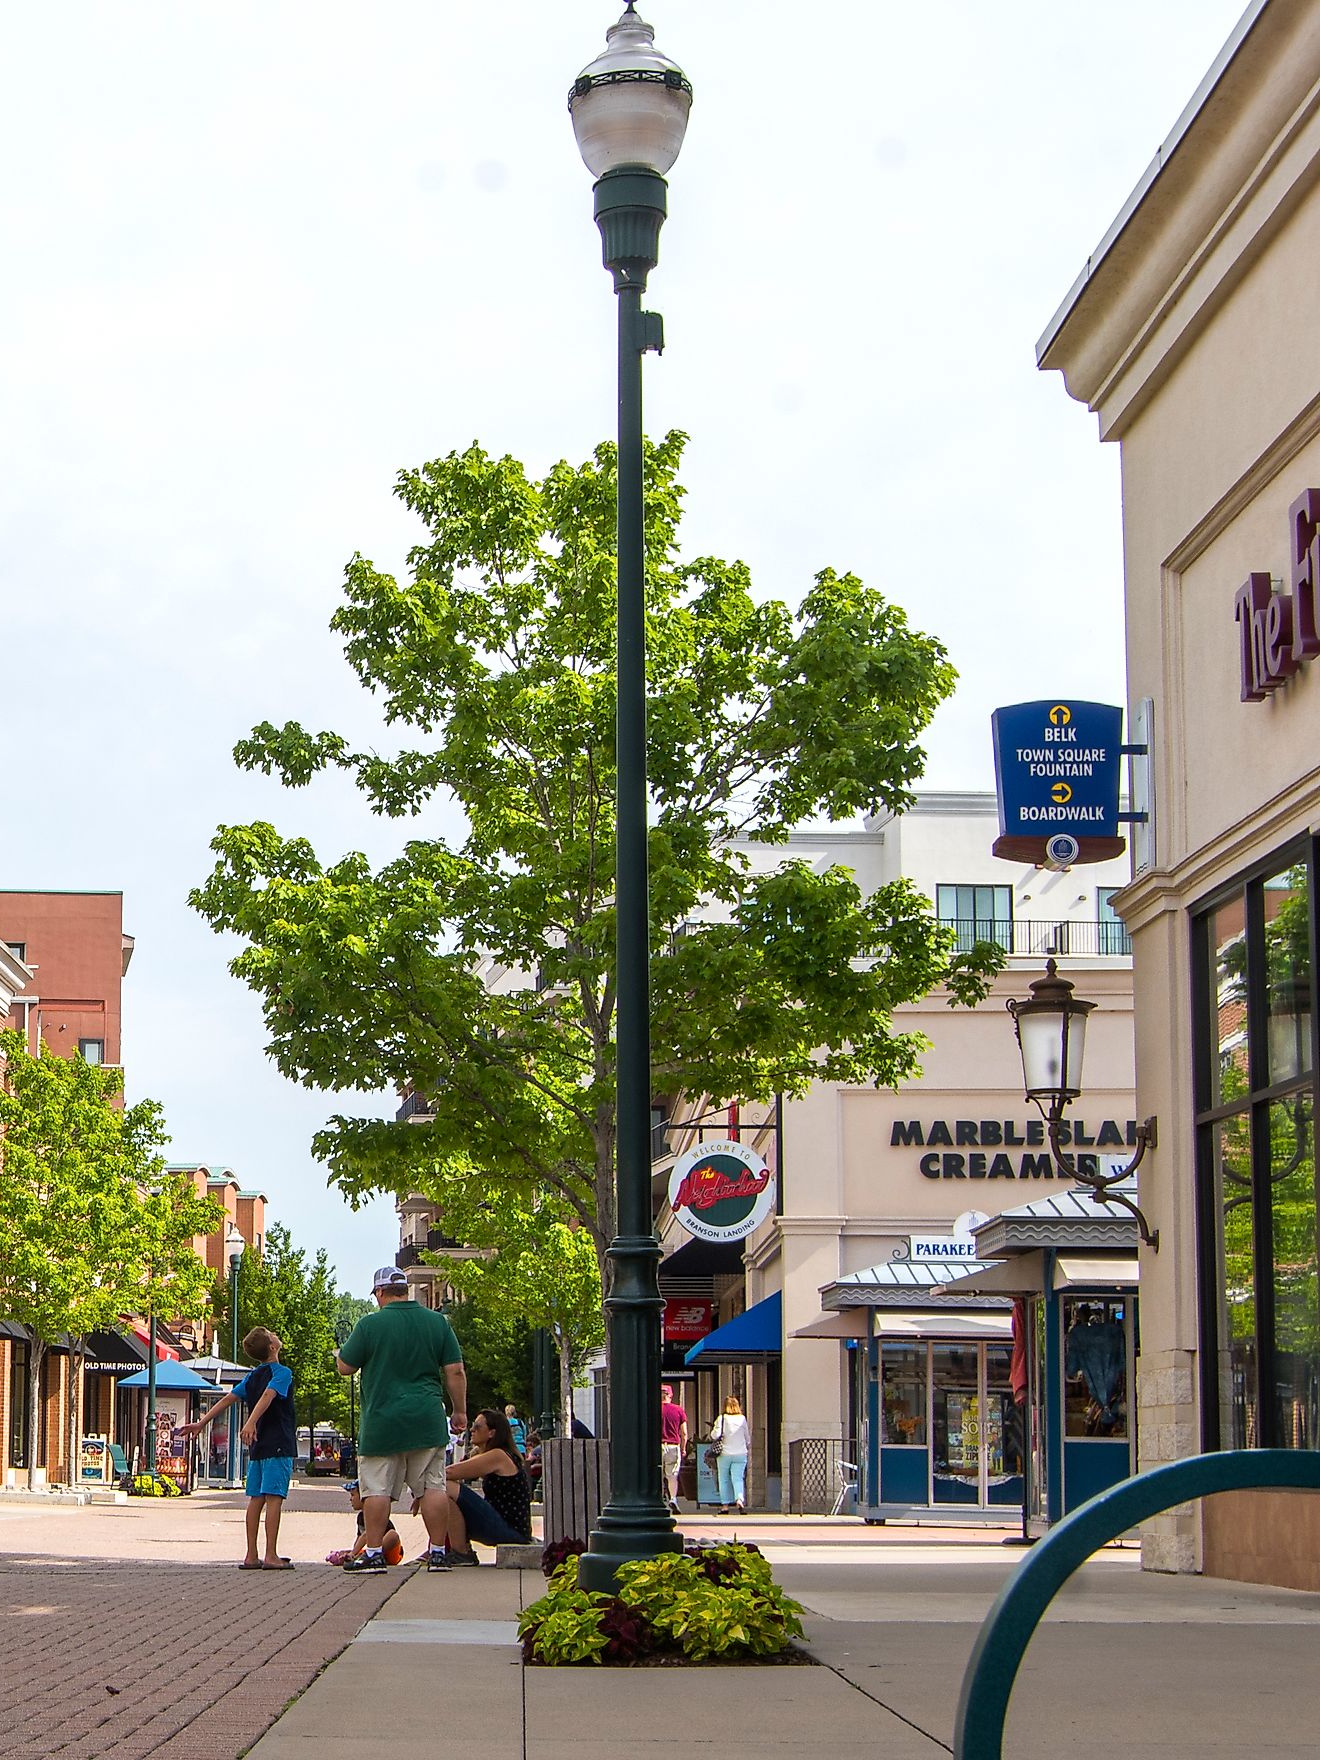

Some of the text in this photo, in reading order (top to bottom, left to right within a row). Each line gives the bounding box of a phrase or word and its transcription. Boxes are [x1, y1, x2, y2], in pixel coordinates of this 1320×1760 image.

[1235, 488, 1320, 702] The F
[1044, 727, 1077, 742] BELK
[1016, 749, 1106, 763] TOWN SQUARE
[1030, 763, 1093, 776] FOUNTAIN
[1020, 806, 1105, 821] BOARDWALK
[890, 1120, 1045, 1147] MARBLE
[691, 1144, 751, 1161] WELCOME TO
[700, 1168, 715, 1180] The
[686, 1218, 755, 1238] BRANSON LANDING
[916, 1243, 975, 1256] PARAKEE
[84, 1362, 146, 1371] OLD TIME PHOTOS
